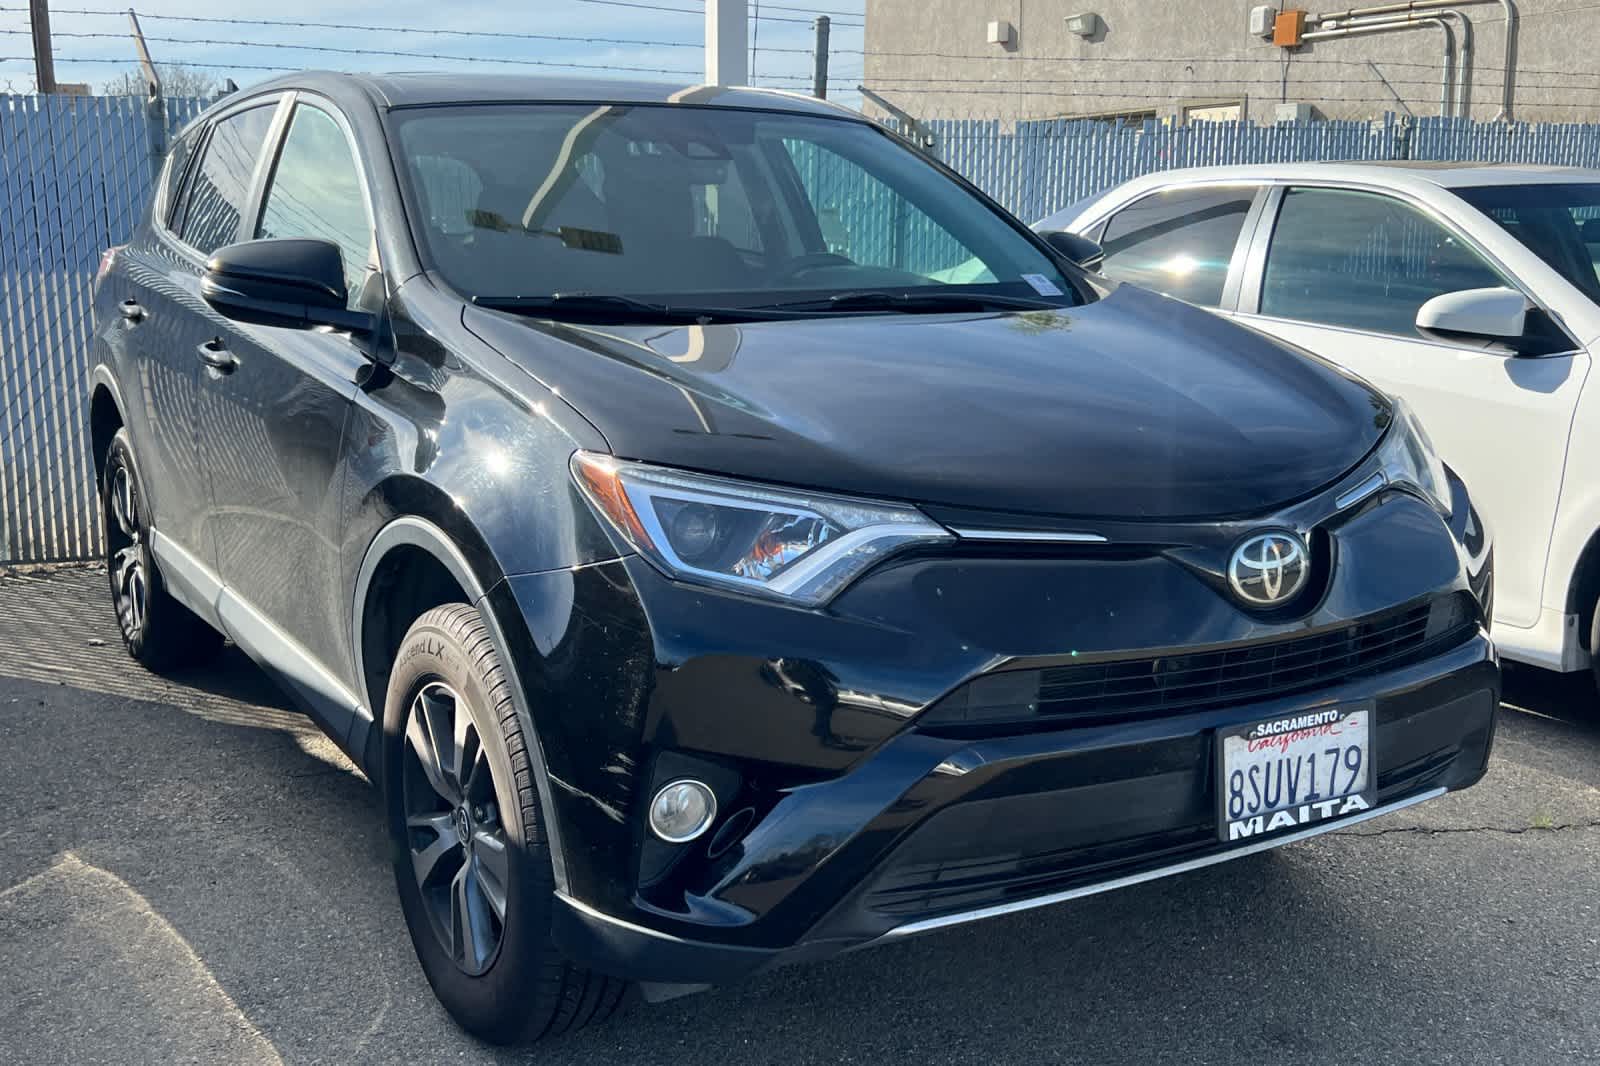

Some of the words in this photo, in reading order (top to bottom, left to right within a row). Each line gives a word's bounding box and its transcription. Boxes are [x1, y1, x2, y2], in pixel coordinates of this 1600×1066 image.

[427, 637, 445, 660] LX
[1257, 709, 1338, 737] SACRAMENTO
[1229, 744, 1361, 819] 8SUV179
[1229, 794, 1370, 841] MAITA
